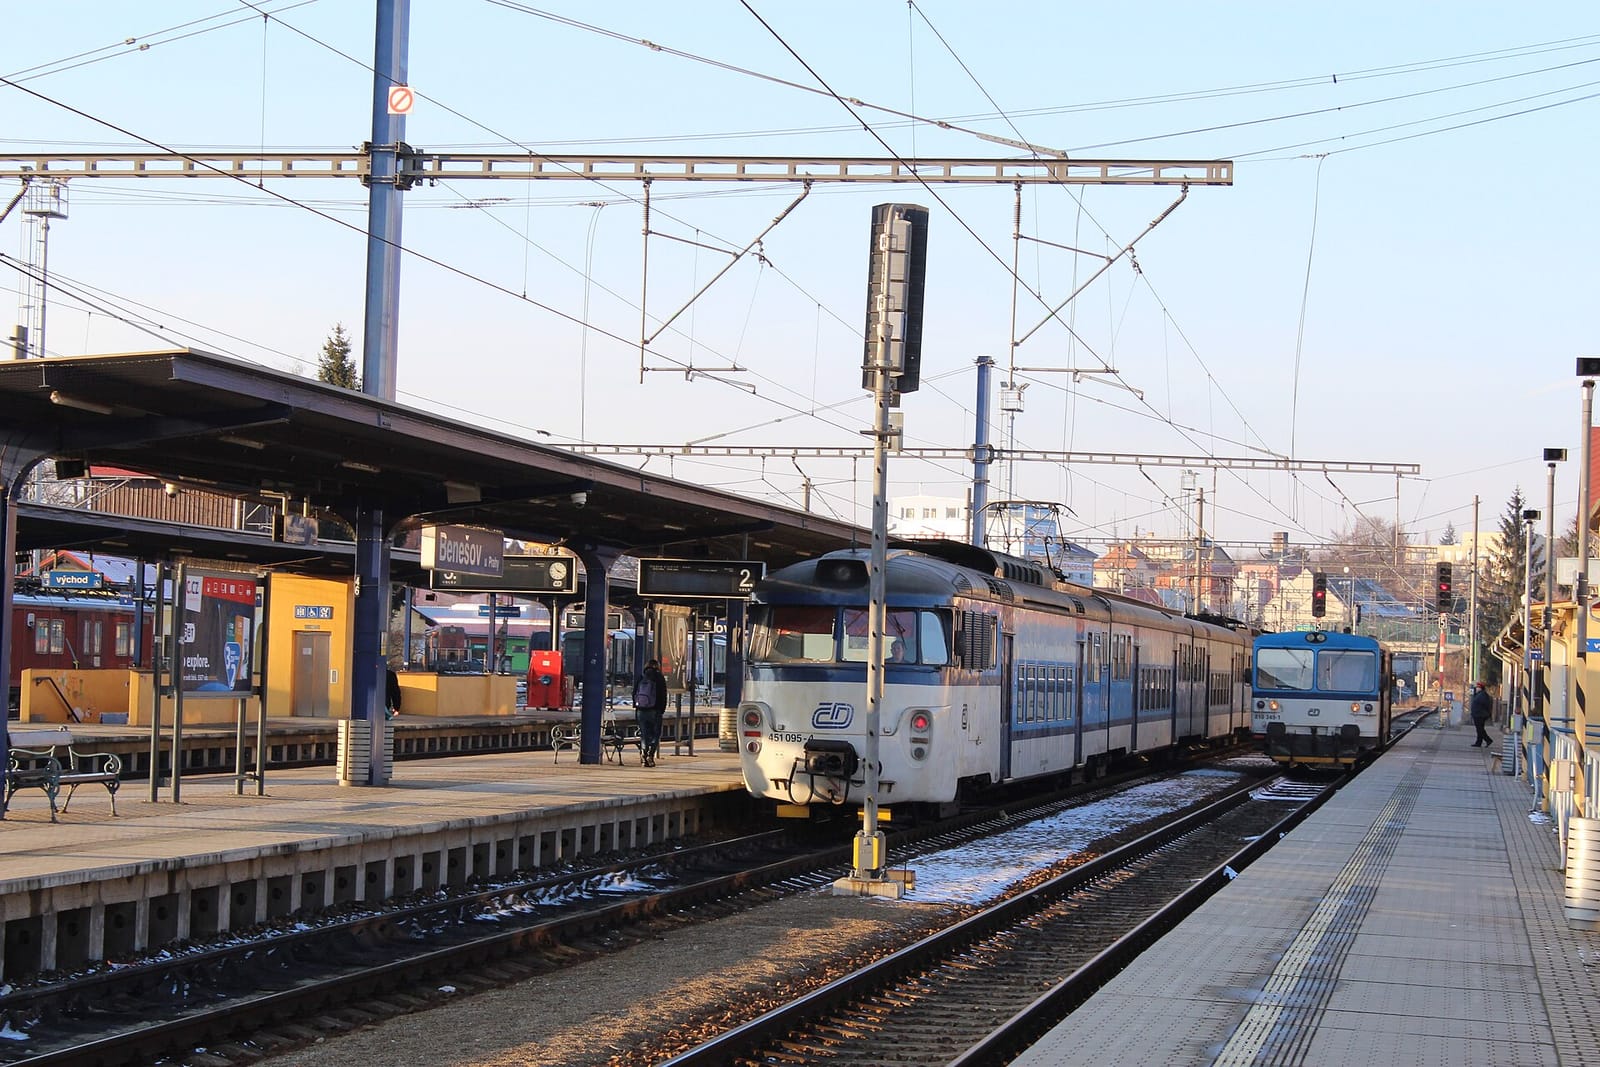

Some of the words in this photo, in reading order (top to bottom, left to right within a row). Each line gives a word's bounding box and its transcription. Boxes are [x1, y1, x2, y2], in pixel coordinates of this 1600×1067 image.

[439, 531, 482, 566] Benešov
[56, 575, 88, 585] východ
[186, 653, 210, 671] explore.
[769, 733, 784, 742] 451
